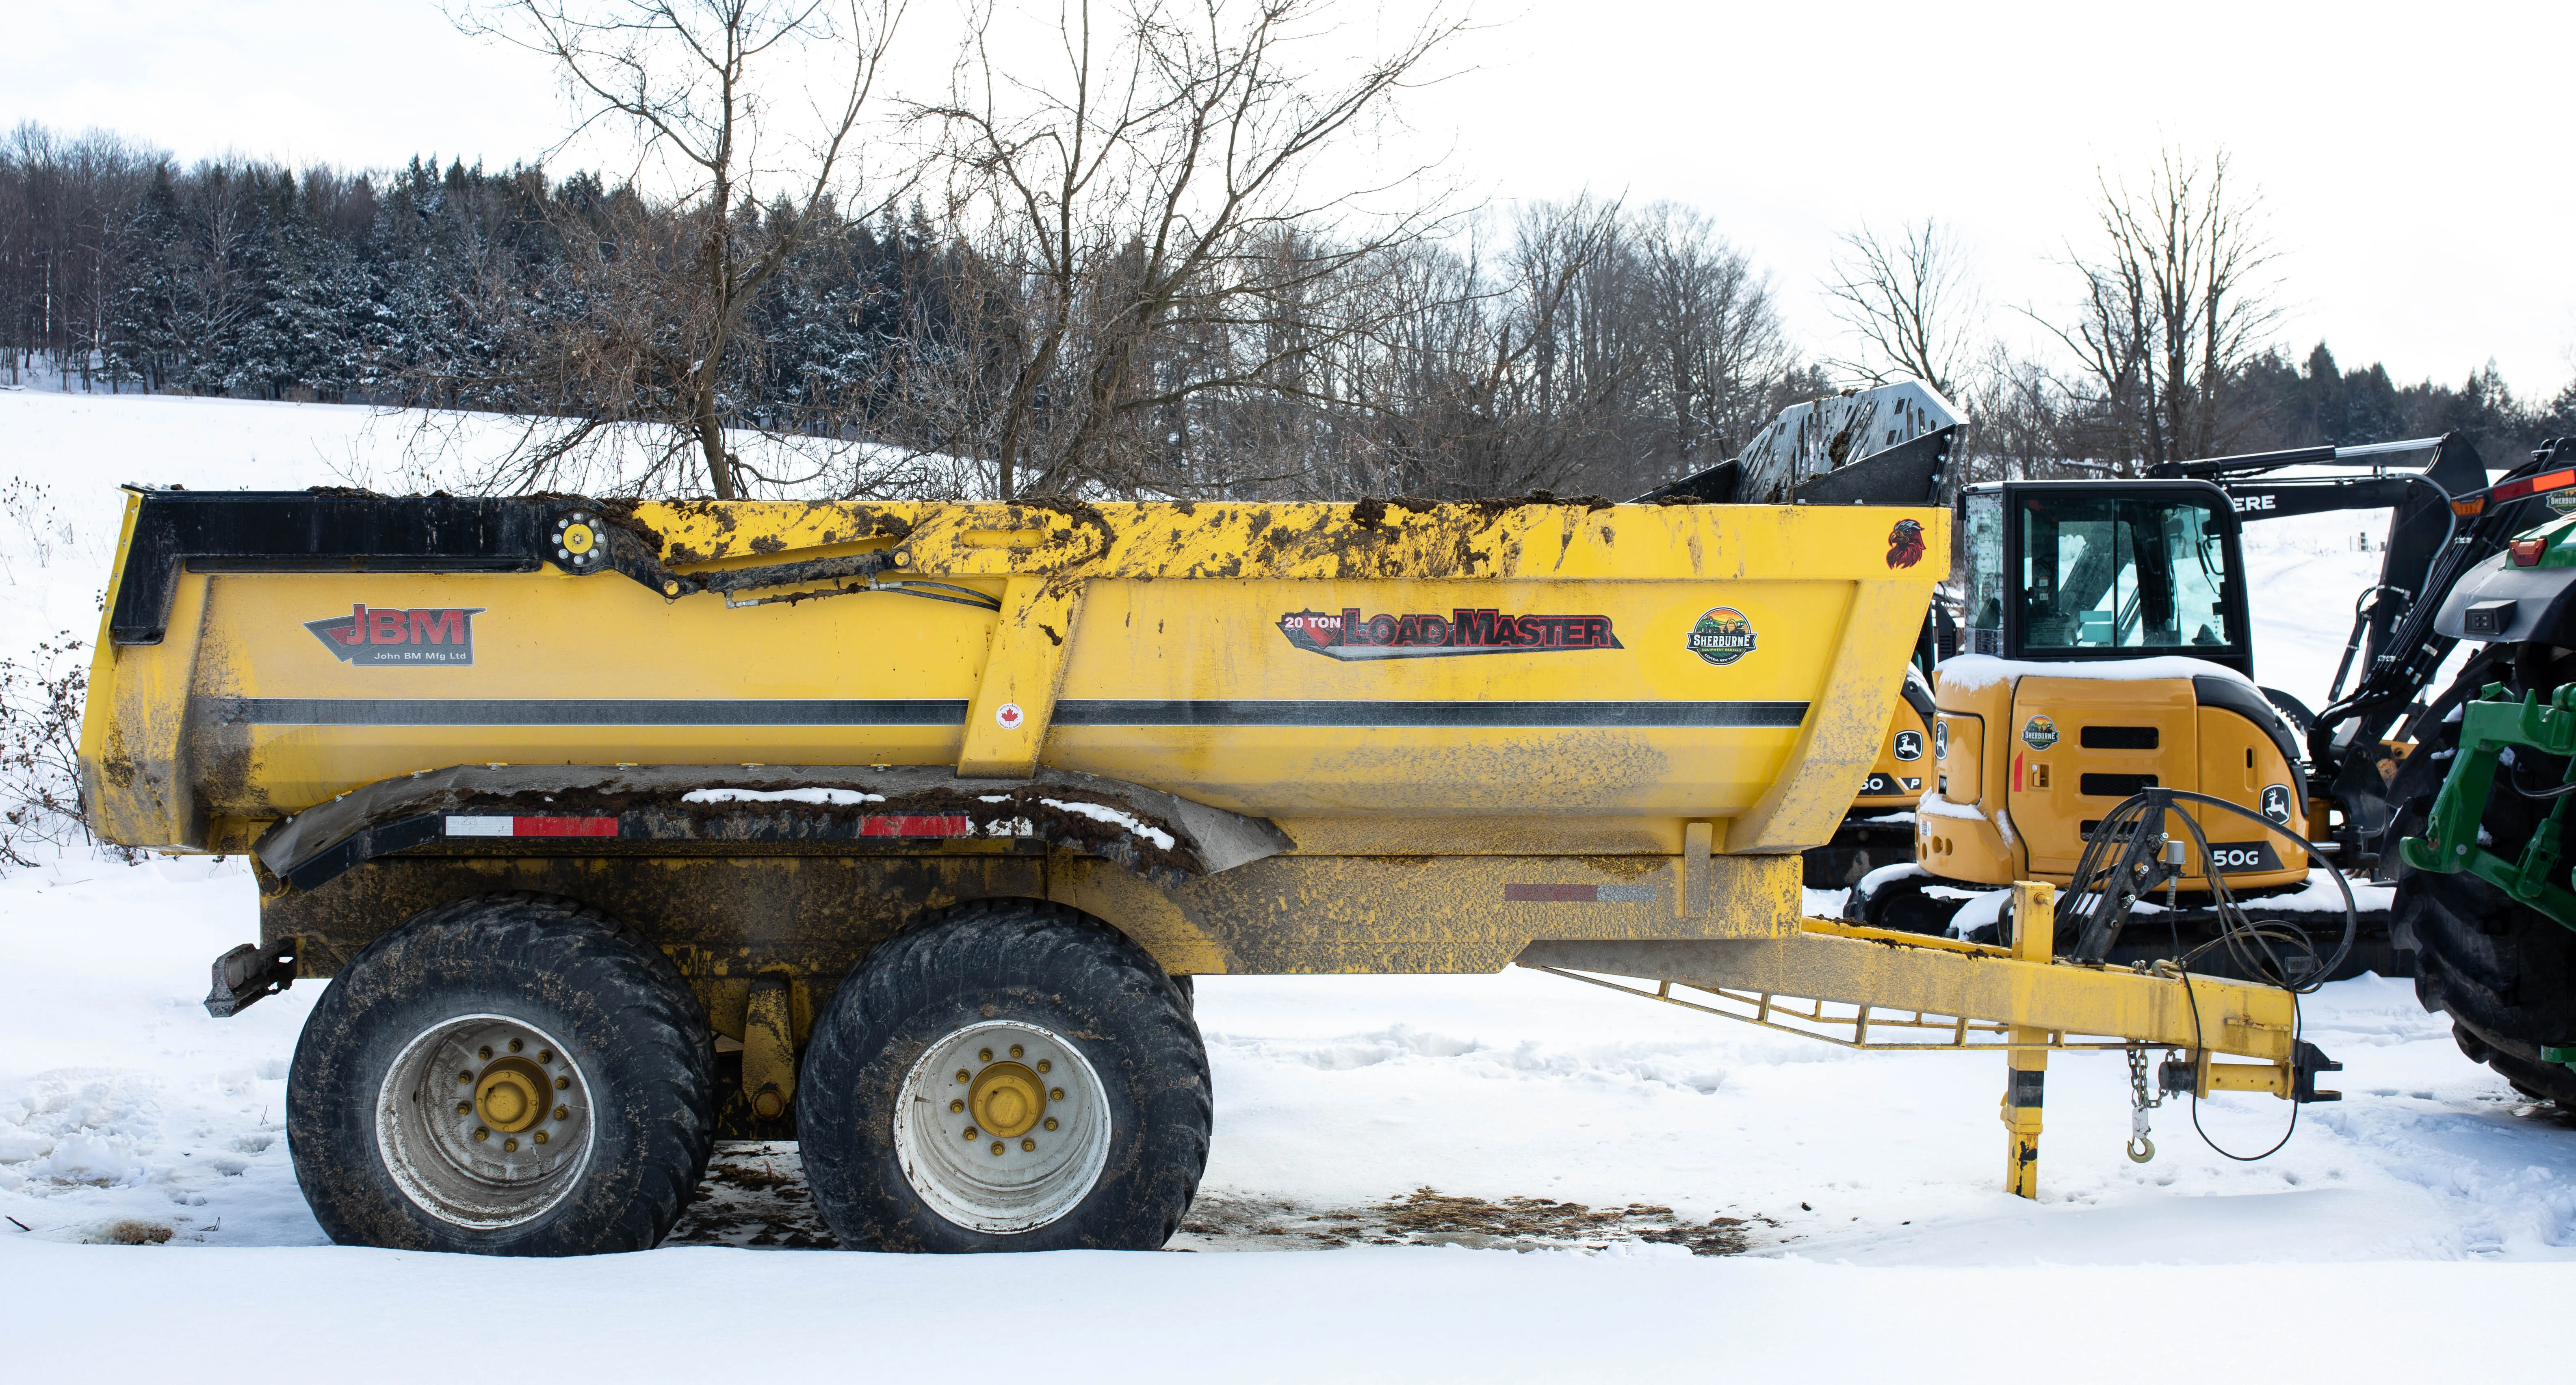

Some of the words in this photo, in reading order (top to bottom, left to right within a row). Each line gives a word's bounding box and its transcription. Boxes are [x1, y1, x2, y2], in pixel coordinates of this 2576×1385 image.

[2233, 495, 2276, 512] ERE
[346, 604, 465, 645] JBM
[1285, 617, 1303, 628] 20
[1308, 617, 1341, 628] TON
[1344, 610, 1449, 647] LOAD
[1454, 610, 1612, 647] MASTER
[1694, 634, 1750, 647] SHERBURNE
[426, 652, 446, 660] Mfg
[1705, 654, 1719, 662] CENTRAL
[2025, 731, 2055, 739] SHERBURNE
[1910, 778, 1920, 789] P
[2213, 849, 2259, 866] 50G
